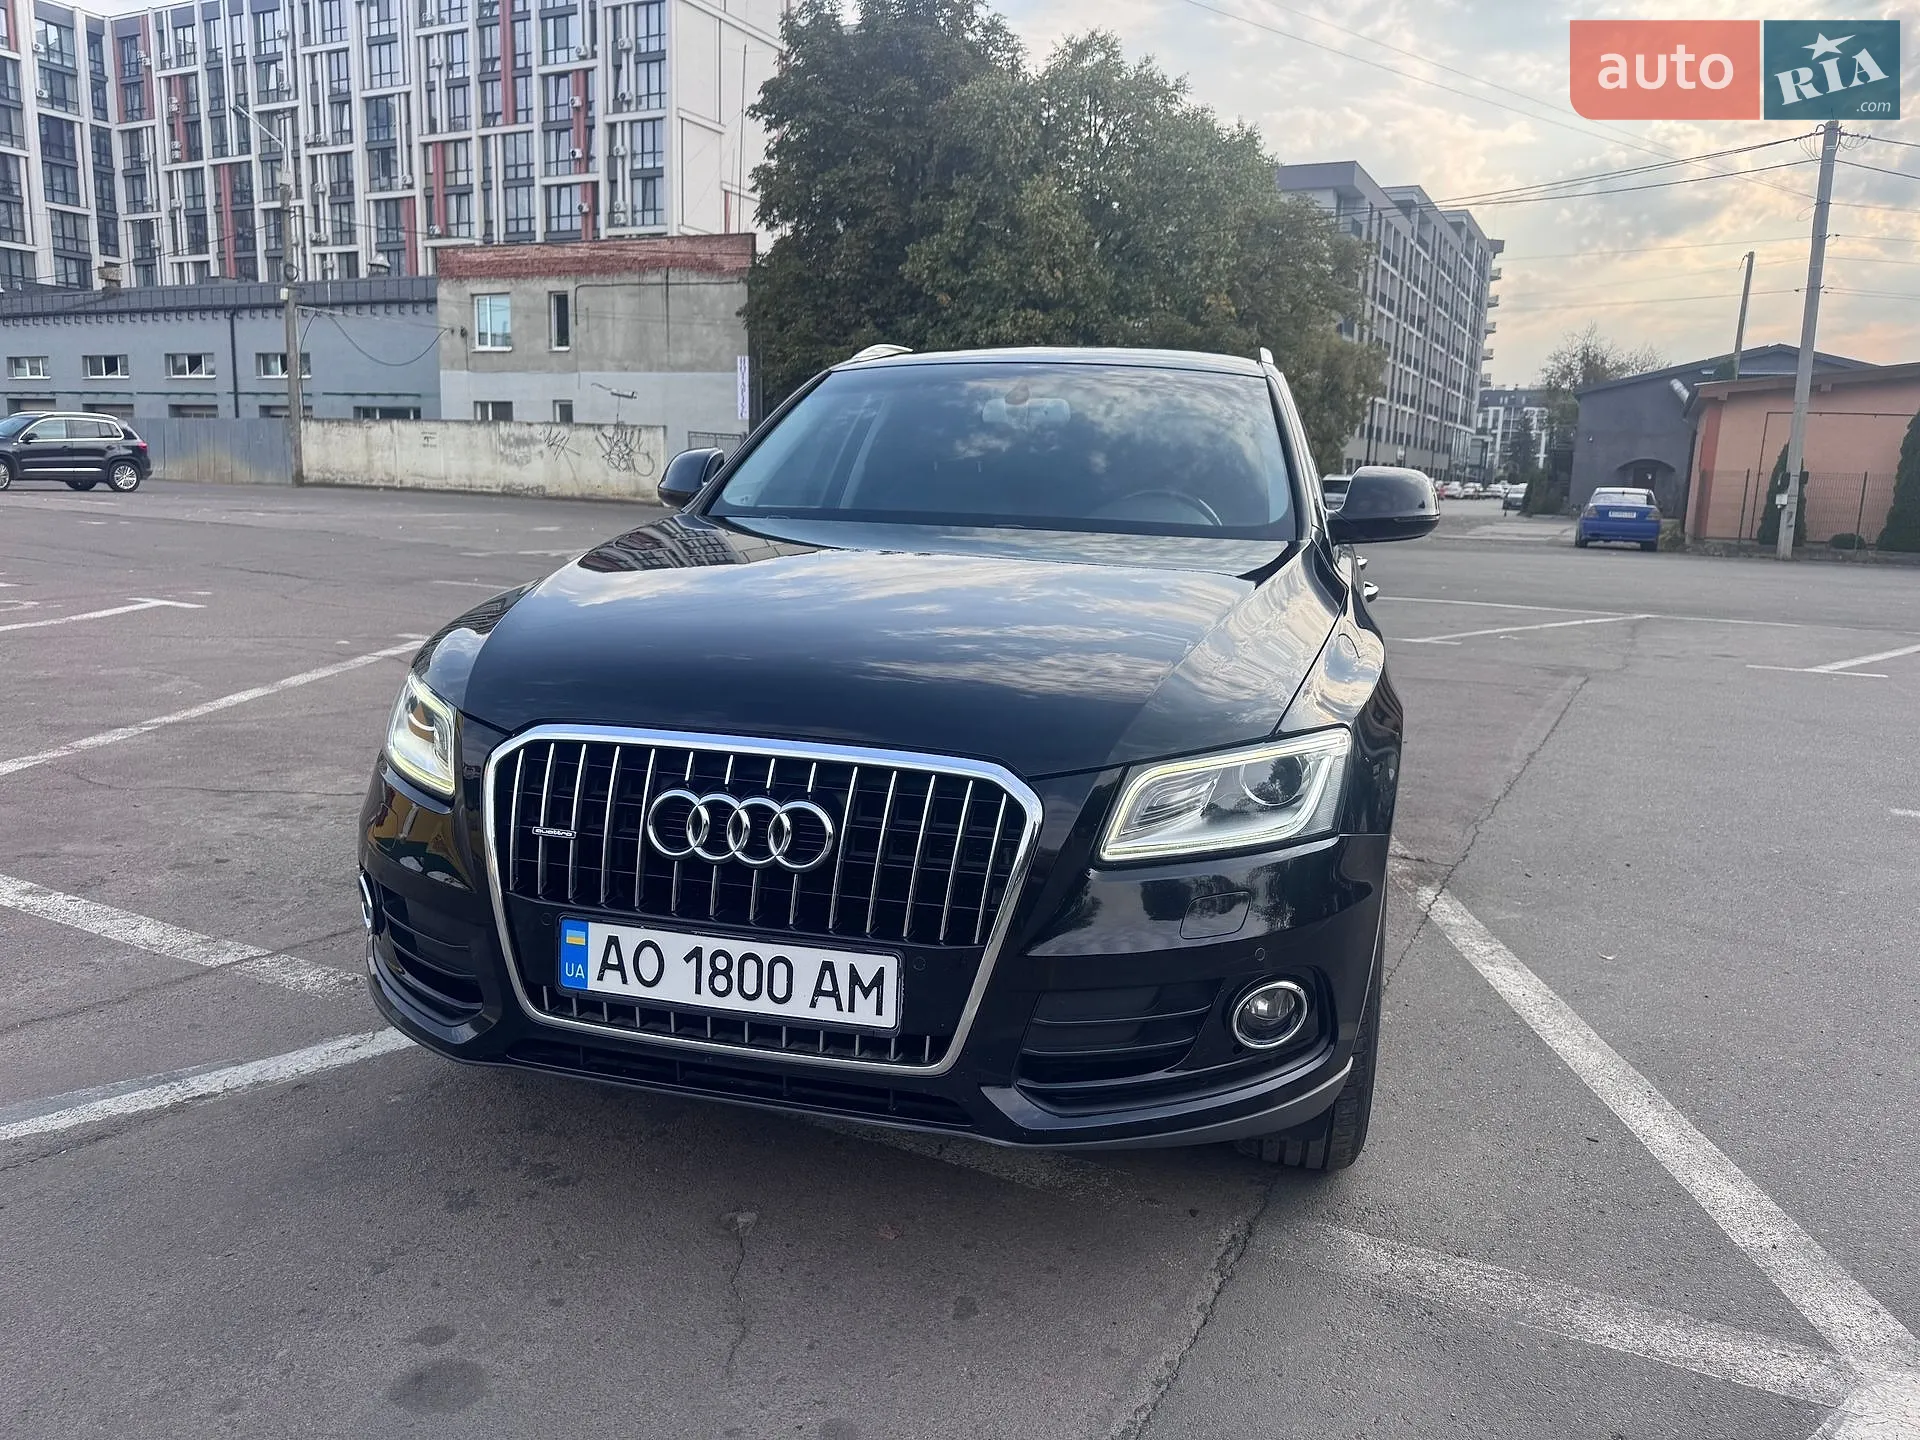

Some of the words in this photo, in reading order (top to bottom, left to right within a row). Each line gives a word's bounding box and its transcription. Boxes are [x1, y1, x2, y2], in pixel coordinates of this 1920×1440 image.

[566, 962, 585, 980] UA
[597, 935, 665, 988] AO
[682, 946, 794, 1005] 1800
[809, 960, 886, 1016] AM
